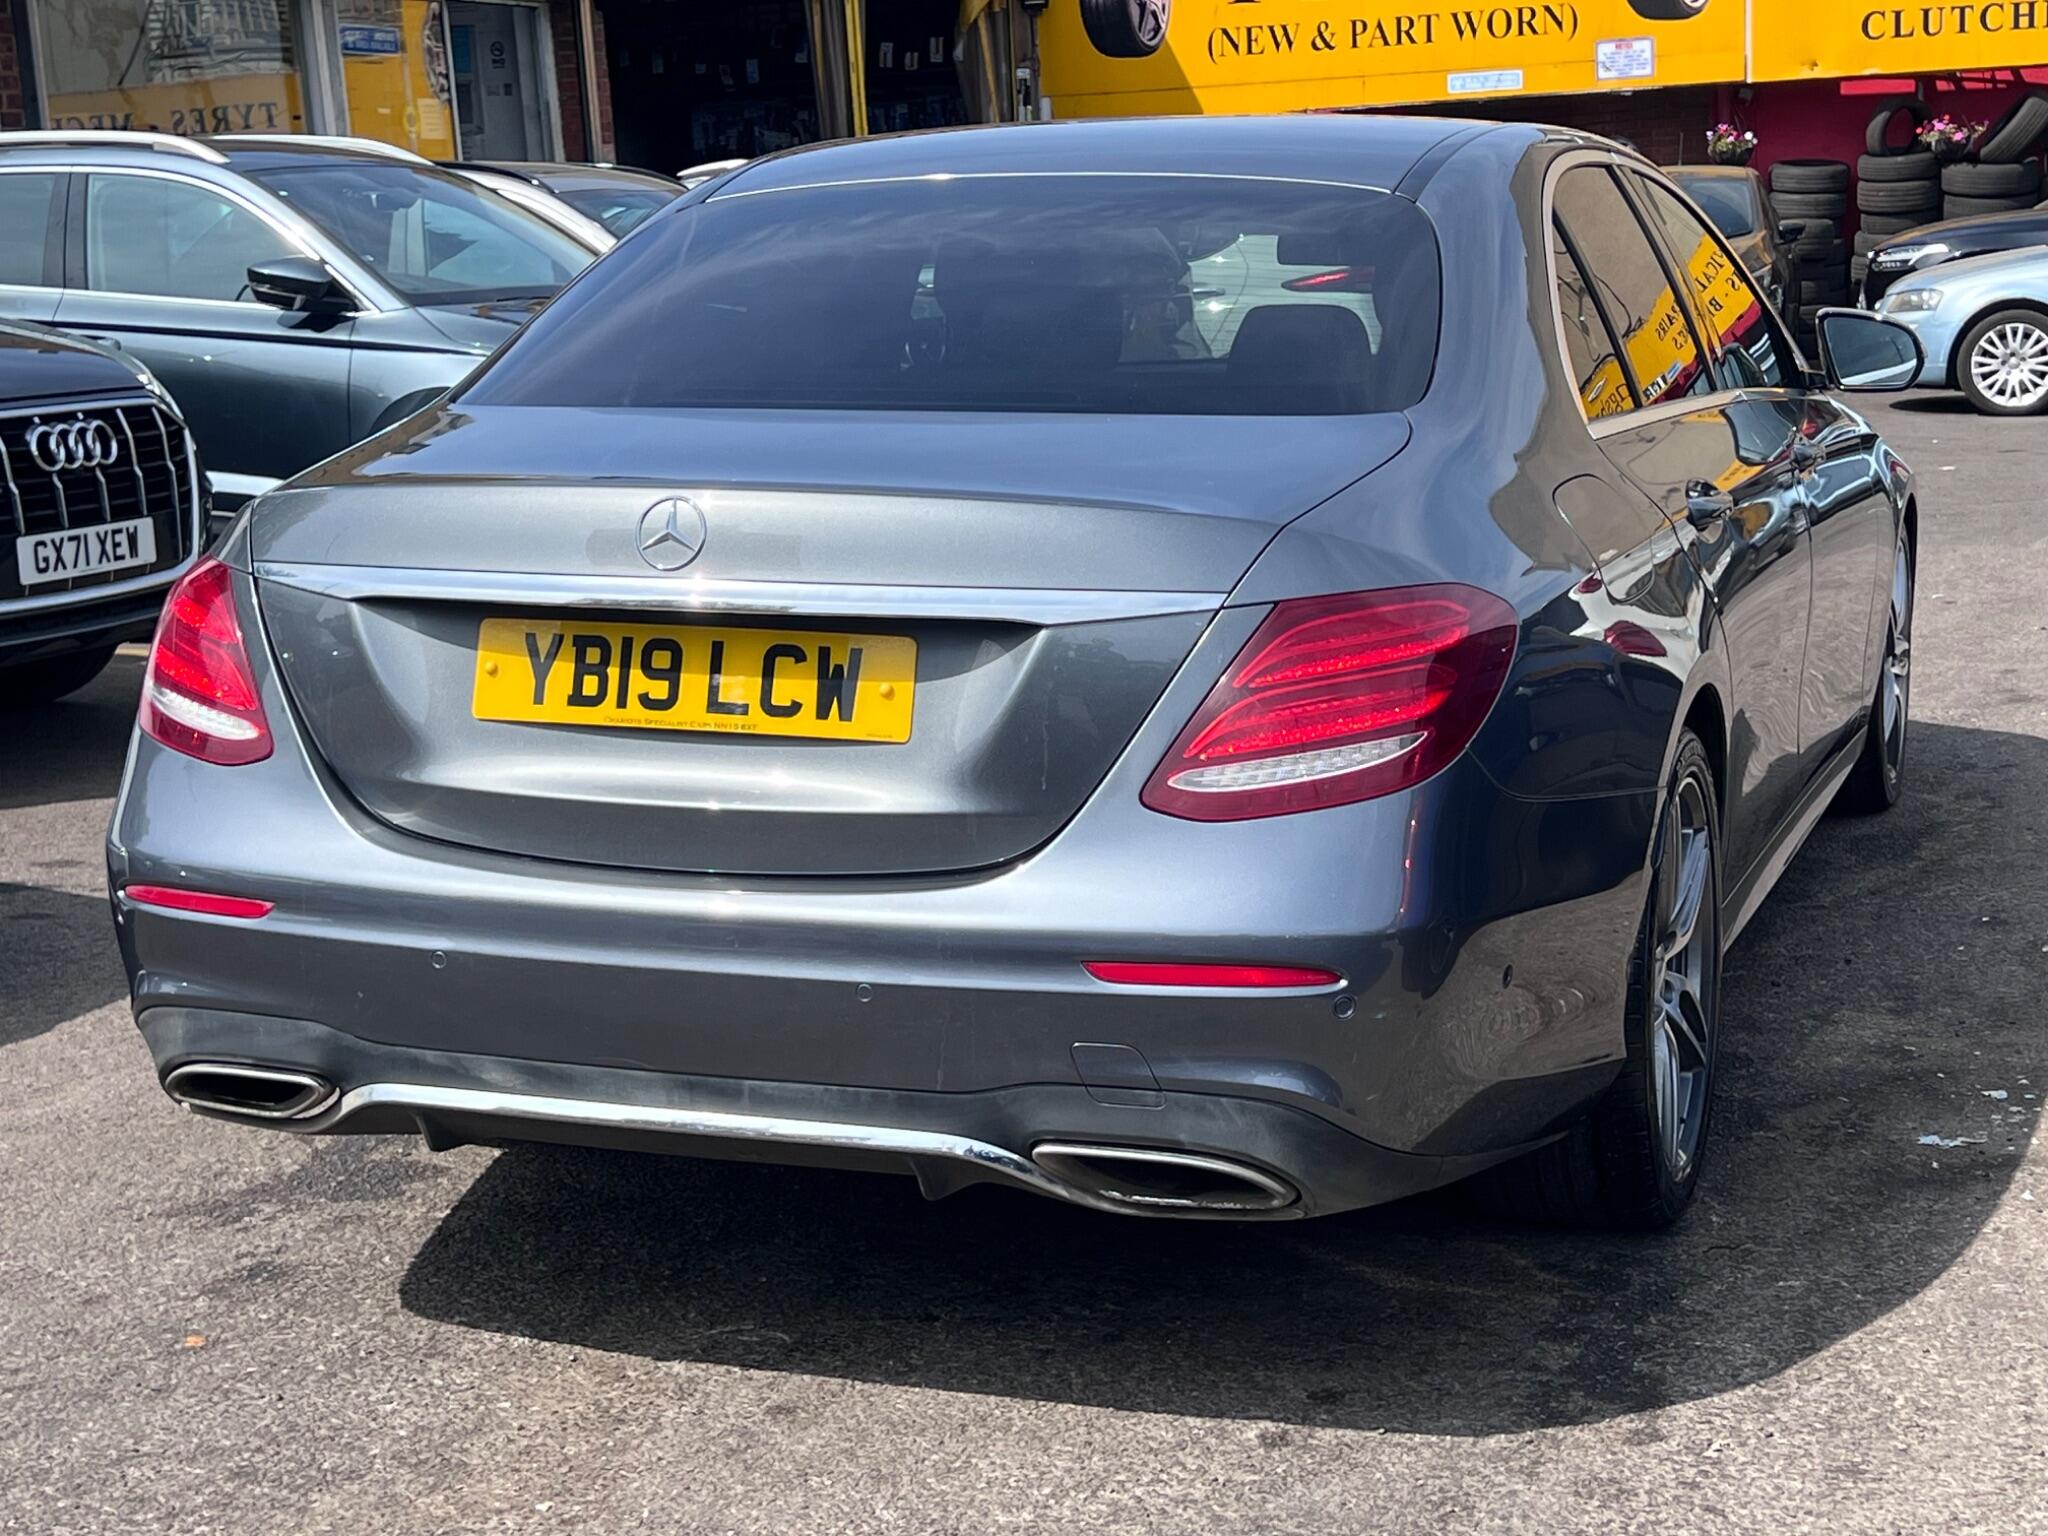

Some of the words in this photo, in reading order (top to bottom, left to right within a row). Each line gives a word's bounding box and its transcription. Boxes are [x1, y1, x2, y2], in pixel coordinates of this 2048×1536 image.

[1207, 22, 1300, 65] (NEW
[1311, 20, 1337, 52] &
[1349, 13, 1440, 49] PART
[1449, 3, 1578, 41] WORN)
[33, 533, 91, 574] GX71
[96, 525, 139, 565] XEW
[525, 632, 684, 711] YB19
[706, 640, 864, 722] LCW
